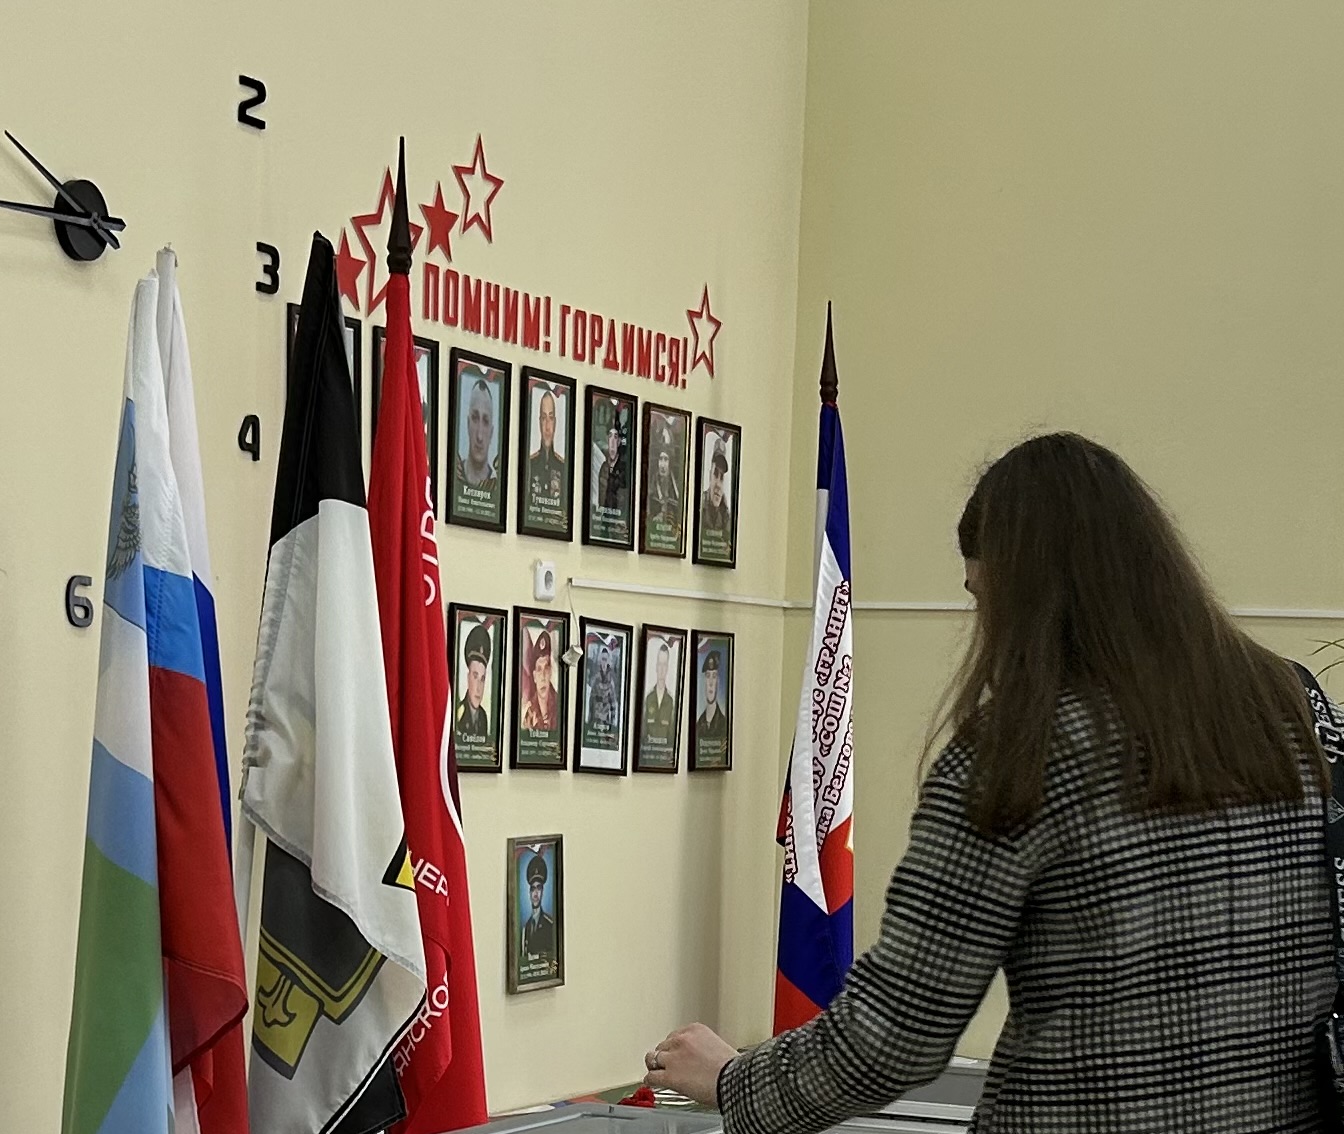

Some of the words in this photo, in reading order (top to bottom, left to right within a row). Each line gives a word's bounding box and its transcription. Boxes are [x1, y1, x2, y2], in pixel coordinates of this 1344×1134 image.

[238, 75, 266, 130] 2
[256, 241, 280, 295] 3
[423, 262, 551, 353] ПОМНИМ!
[560, 304, 688, 389] ГОРДИМСЯ!
[238, 414, 261, 461] 4
[65, 575, 93, 629] 6
[819, 691, 846, 757] «СОШ
